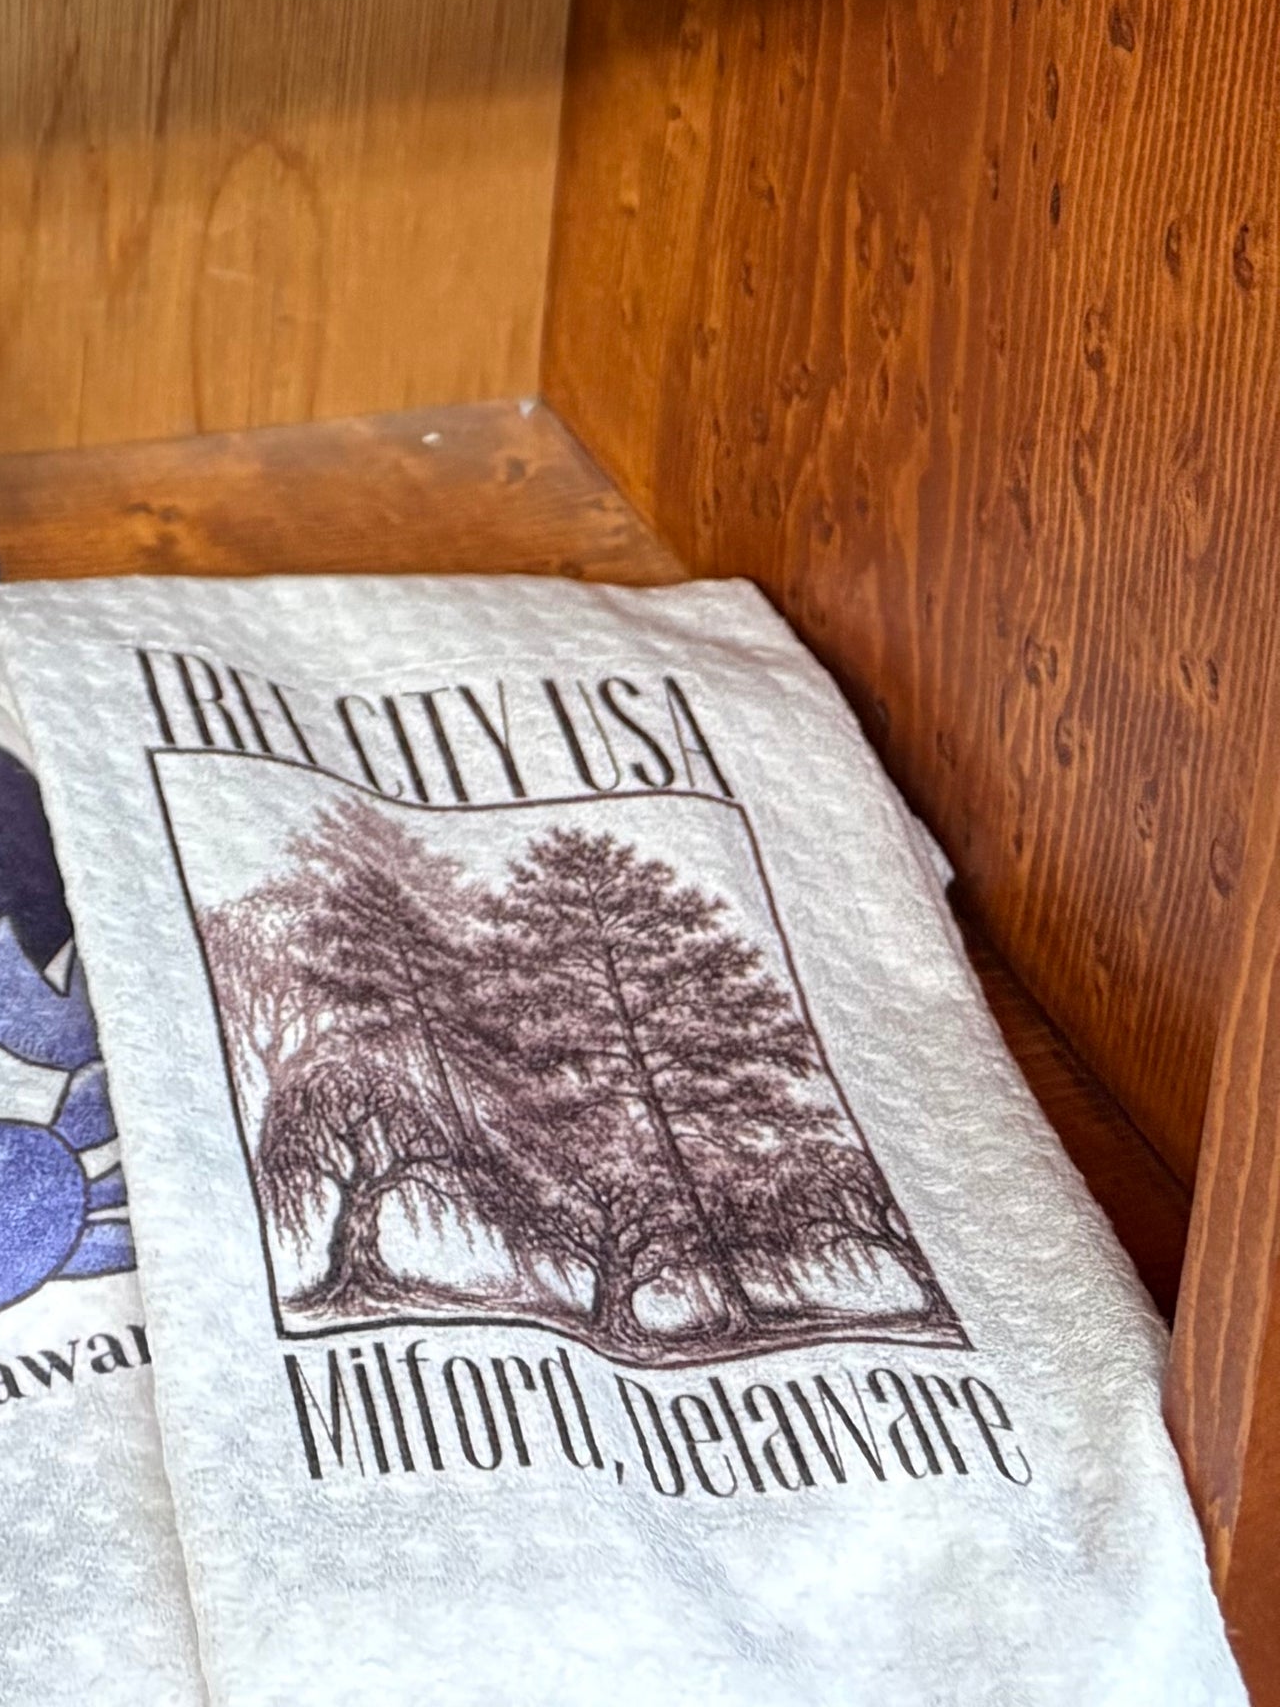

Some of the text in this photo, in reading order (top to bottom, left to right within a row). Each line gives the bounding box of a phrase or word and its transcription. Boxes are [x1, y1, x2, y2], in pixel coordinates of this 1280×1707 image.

[333, 680, 528, 804] CITY
[542, 677, 735, 800] USA
[282, 1337, 626, 1486] Milford,
